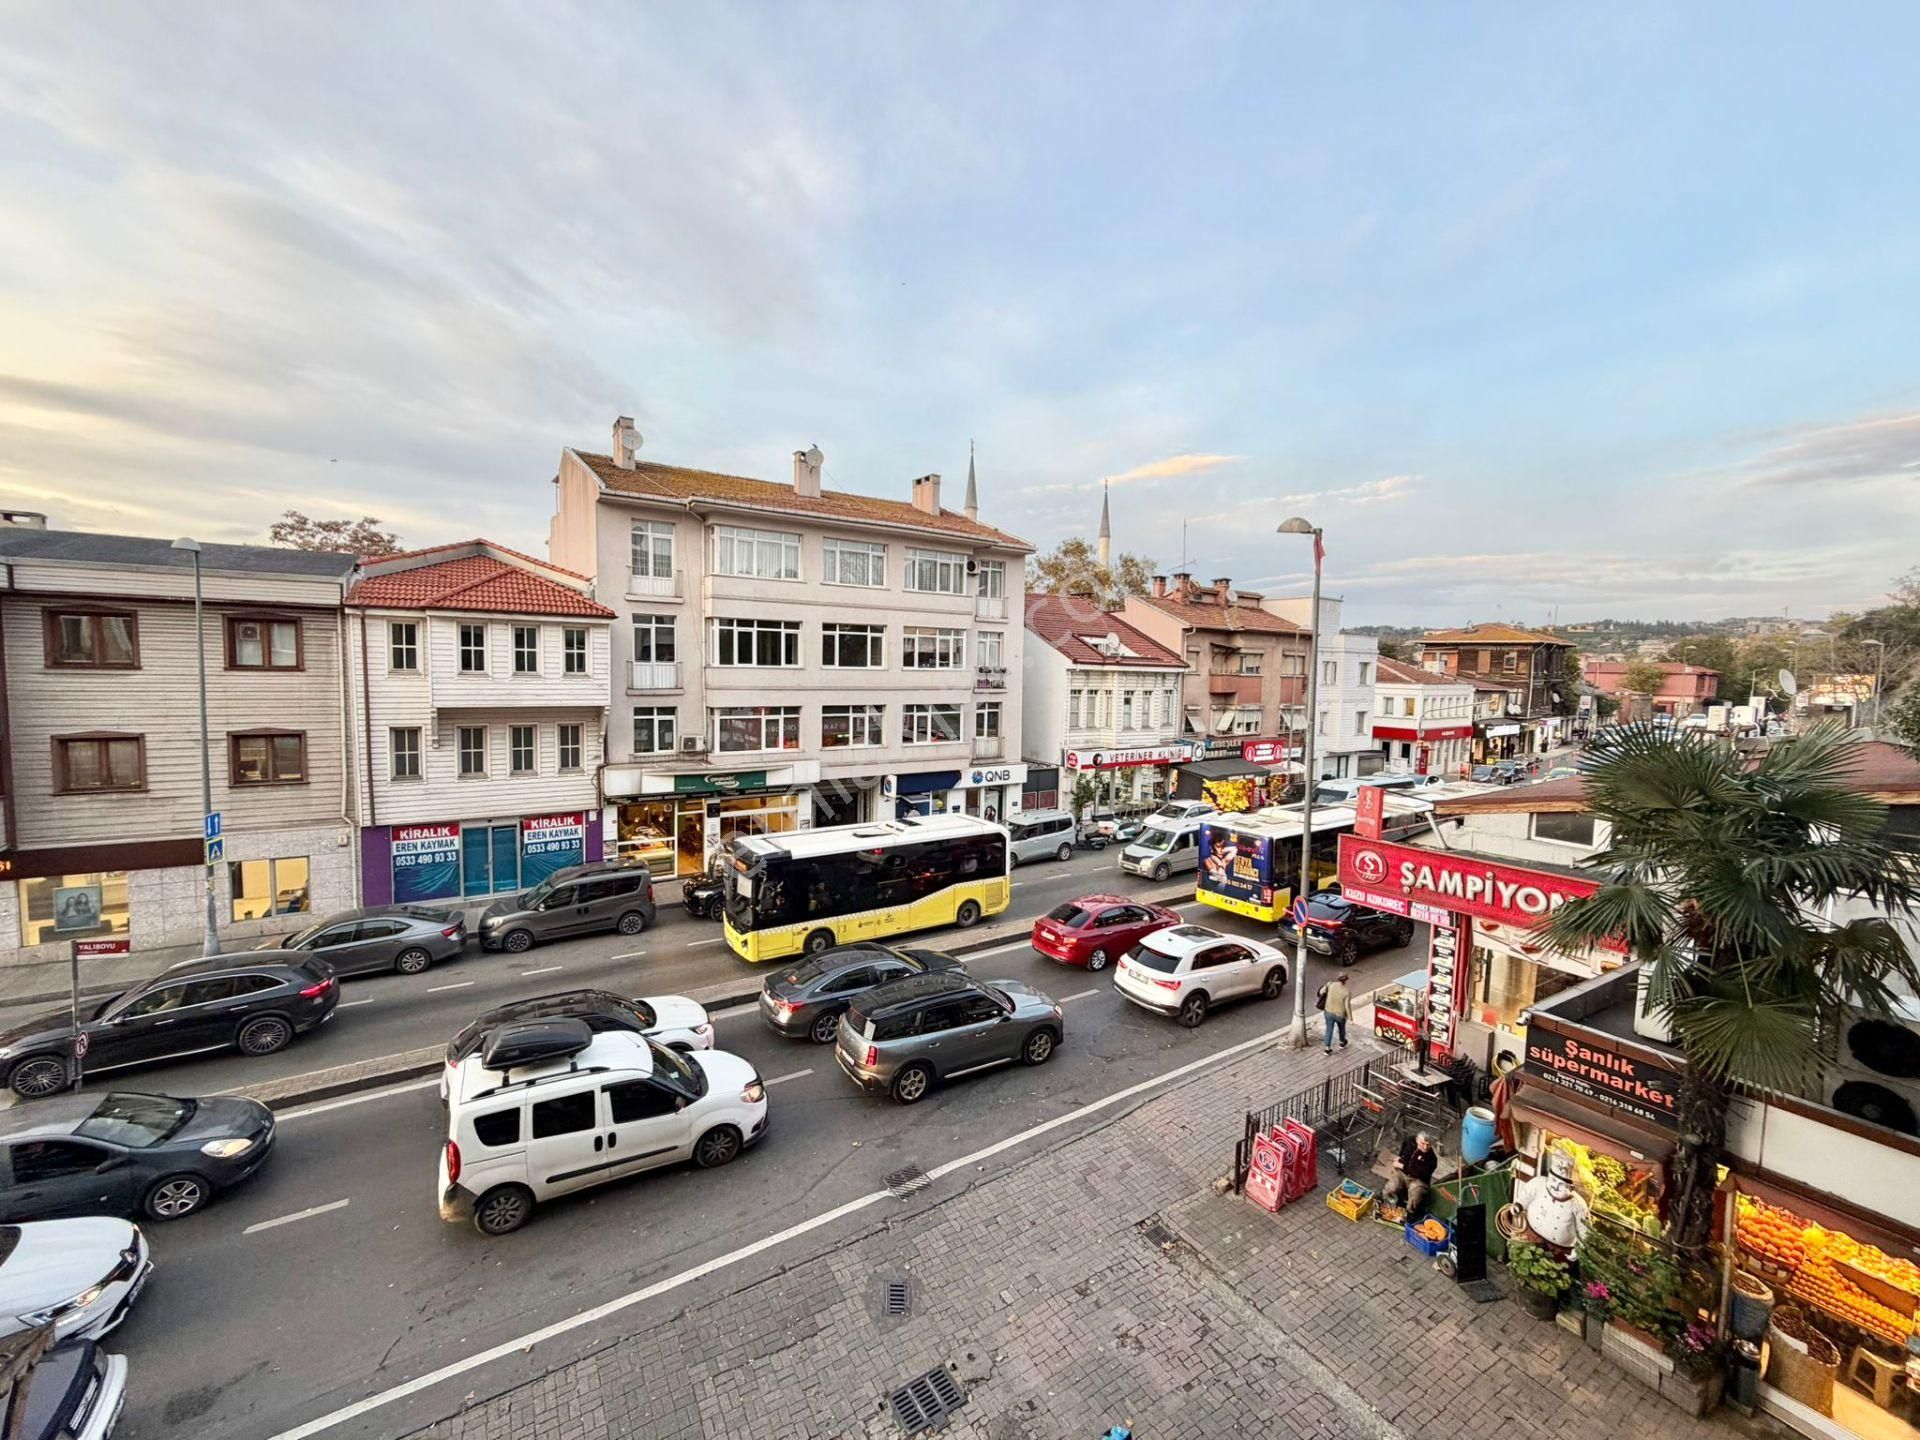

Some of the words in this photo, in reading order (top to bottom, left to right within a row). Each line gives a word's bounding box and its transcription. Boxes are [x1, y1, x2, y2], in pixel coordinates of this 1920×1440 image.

[985, 769, 1011, 782] QNB
[531, 815, 576, 830] KİRALIK
[400, 826, 451, 840] KİRALIK
[527, 830, 547, 841] EREN
[549, 827, 580, 839] KAYMAK
[395, 841, 418, 853] EREN
[420, 837, 456, 850] KAYMAK
[527, 843, 546, 854] 0533
[547, 841, 560, 852] 490
[561, 840, 570, 850] 93
[571, 839, 580, 849] 33
[395, 855, 416, 867] 0533
[417, 853, 433, 864] 490
[434, 852, 445, 863] 93
[446, 851, 457, 862] 33
[1345, 887, 1366, 902] KUZU
[1367, 891, 1406, 914] KOKOREÇ
[1564, 1038, 1635, 1077] Şanlık
[1529, 1045, 1675, 1109] süpermarket
[1543, 1072, 1560, 1084] 0216
[1574, 1082, 1584, 1093] 70
[1600, 1093, 1618, 1107] 0216
